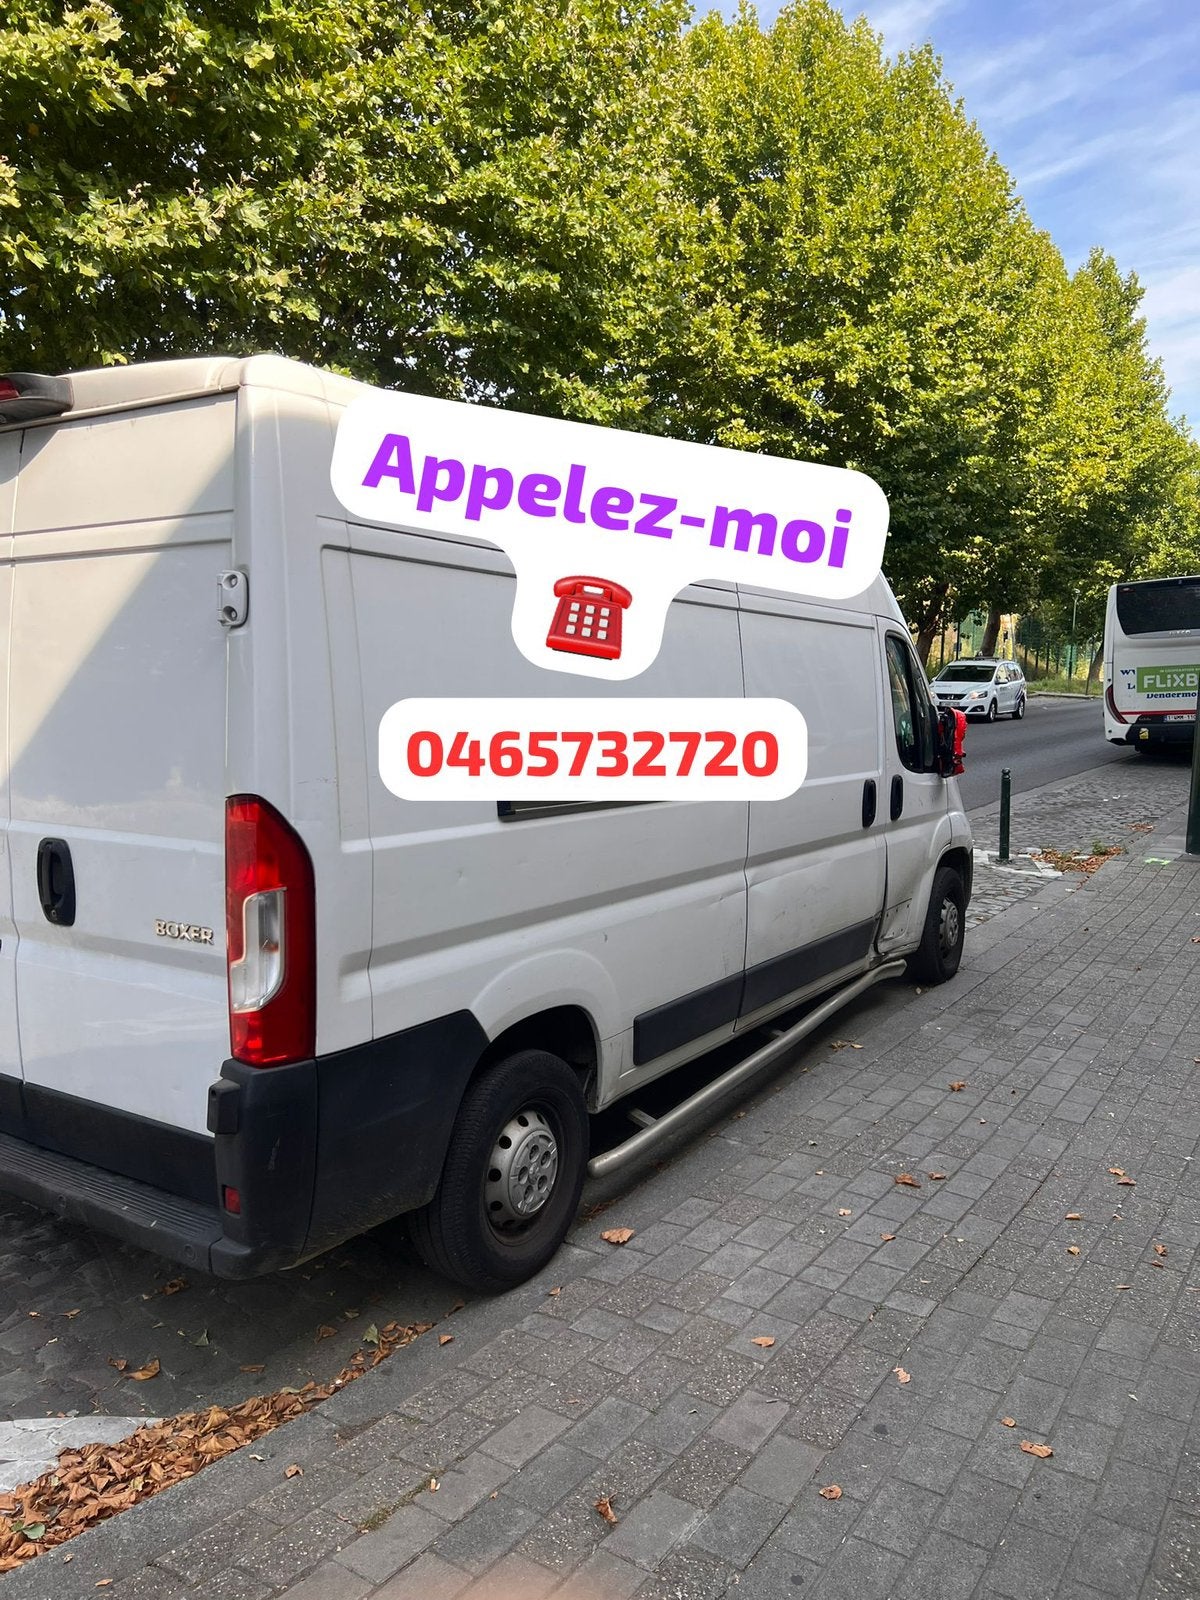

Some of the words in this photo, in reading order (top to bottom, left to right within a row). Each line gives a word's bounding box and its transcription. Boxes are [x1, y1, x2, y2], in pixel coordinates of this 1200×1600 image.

[1143, 673, 1199, 689] FLiXB
[1146, 691, 1198, 699] Dendermo
[155, 919, 215, 945] BOXER
